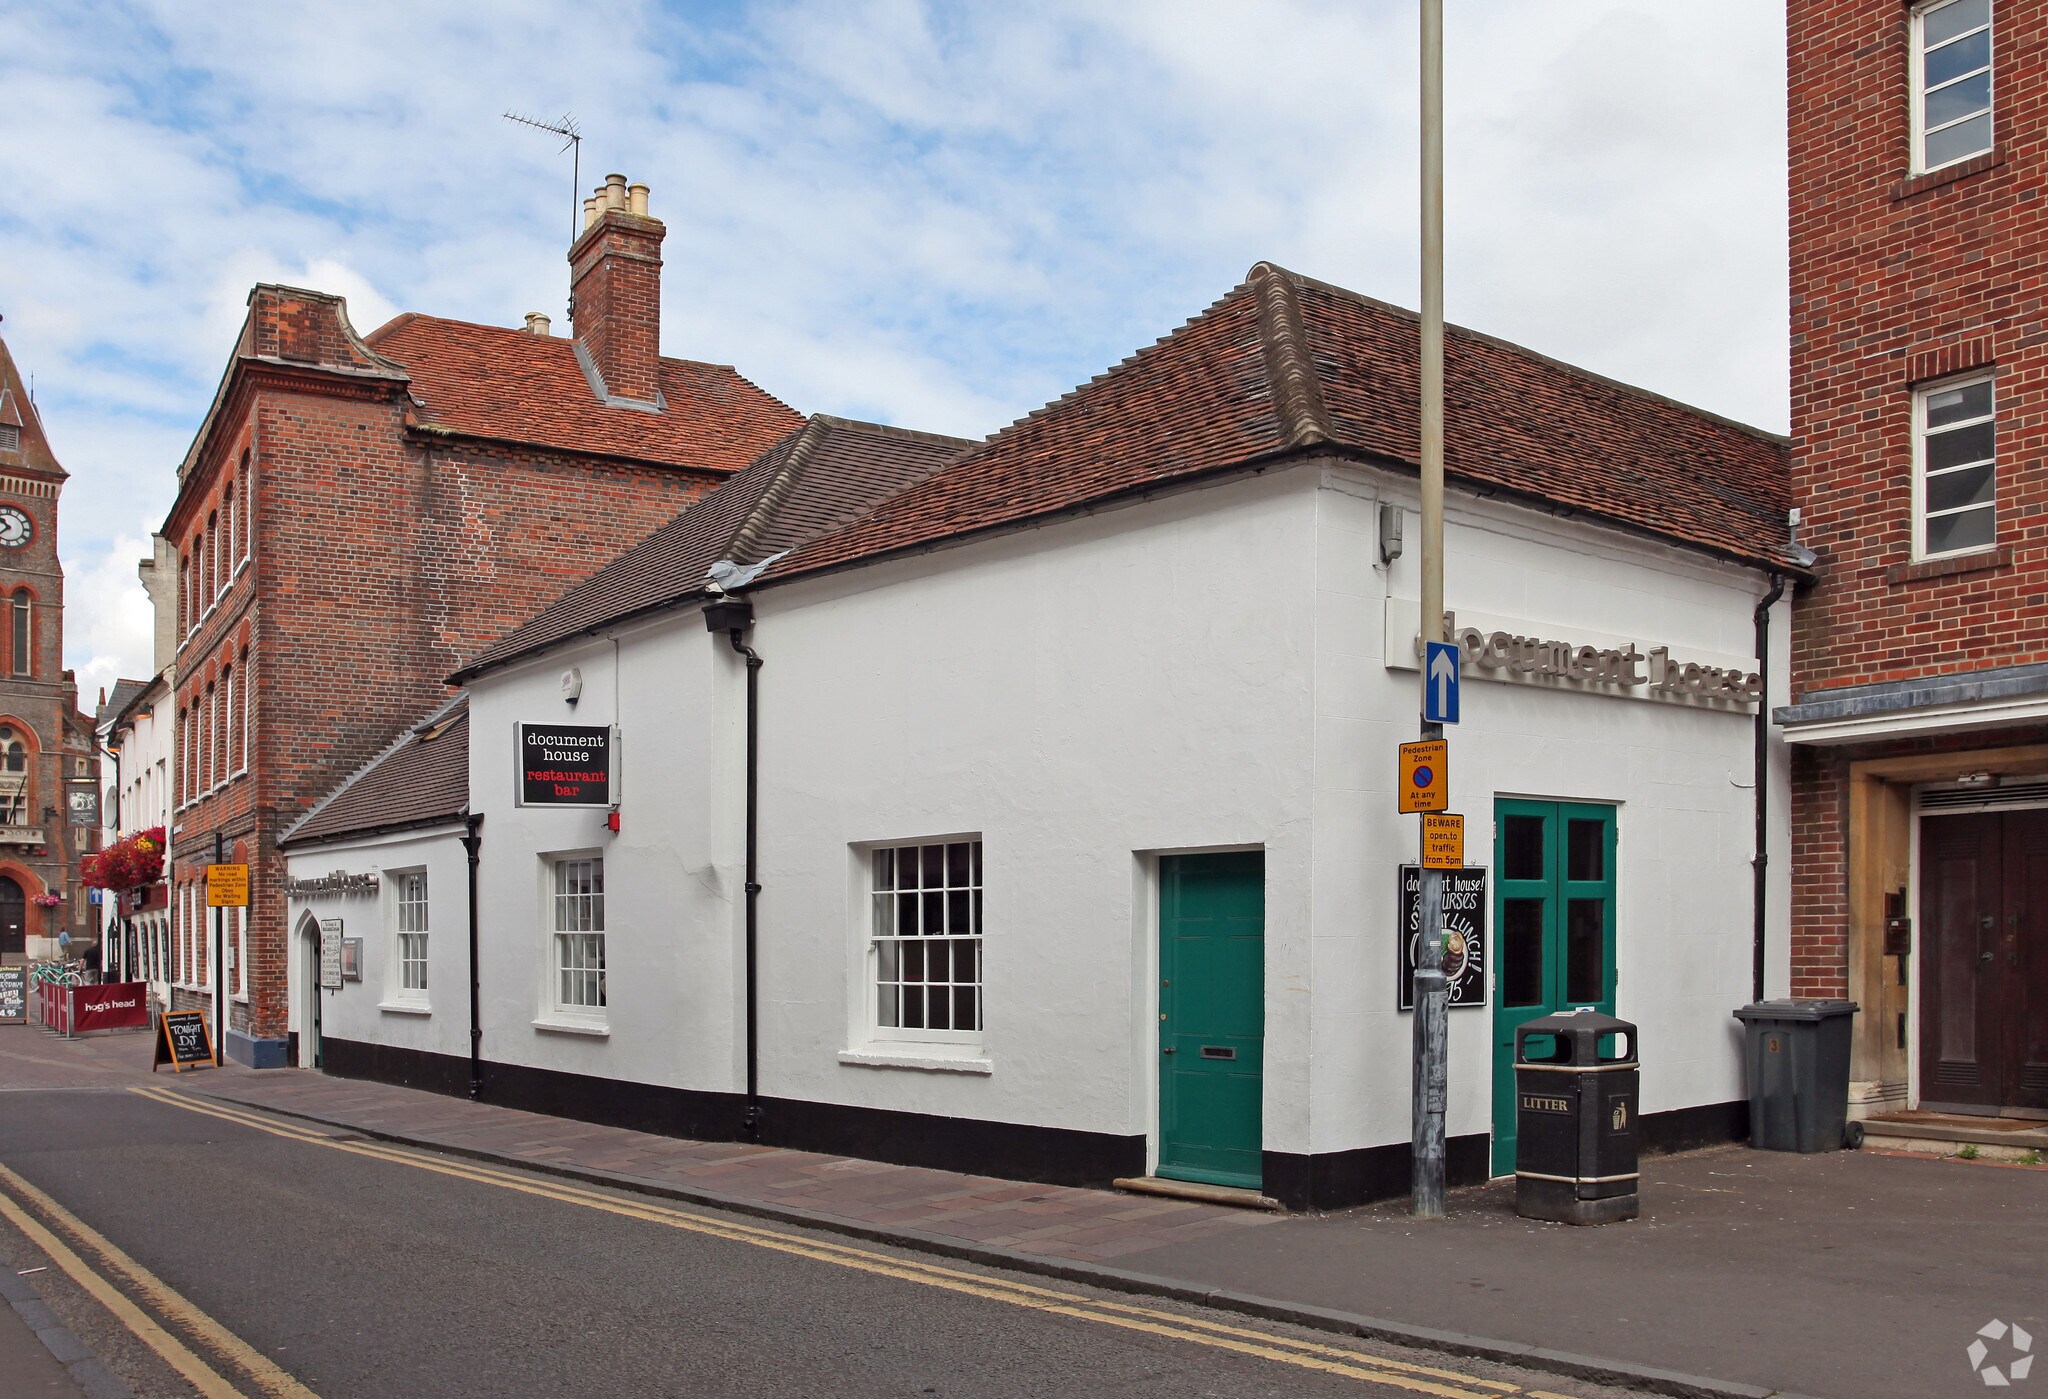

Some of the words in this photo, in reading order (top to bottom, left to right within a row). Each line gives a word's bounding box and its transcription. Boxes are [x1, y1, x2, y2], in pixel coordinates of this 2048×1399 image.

[1649, 646, 1764, 703] house
[527, 733, 604, 747] document
[543, 748, 589, 762] house
[1403, 744, 1444, 755] Pedestrian
[1413, 755, 1432, 763] Zone
[527, 769, 606, 782] restaurant
[553, 783, 580, 796] bar
[1410, 791, 1419, 799] At
[1421, 791, 1436, 799] any
[1414, 800, 1431, 808] time
[1427, 818, 1461, 828] BEWARE
[1430, 832, 1448, 841] open
[1449, 831, 1457, 840] to
[1432, 843, 1455, 853] traffic
[1425, 855, 1443, 864] from
[1445, 855, 1461, 865] 5pm
[1455, 875, 1485, 892] house!
[85, 1001, 111, 1013] hog's
[111, 998, 136, 1009] head
[177, 1035, 198, 1046] DJ
[1523, 1097, 1568, 1112] LITTER
